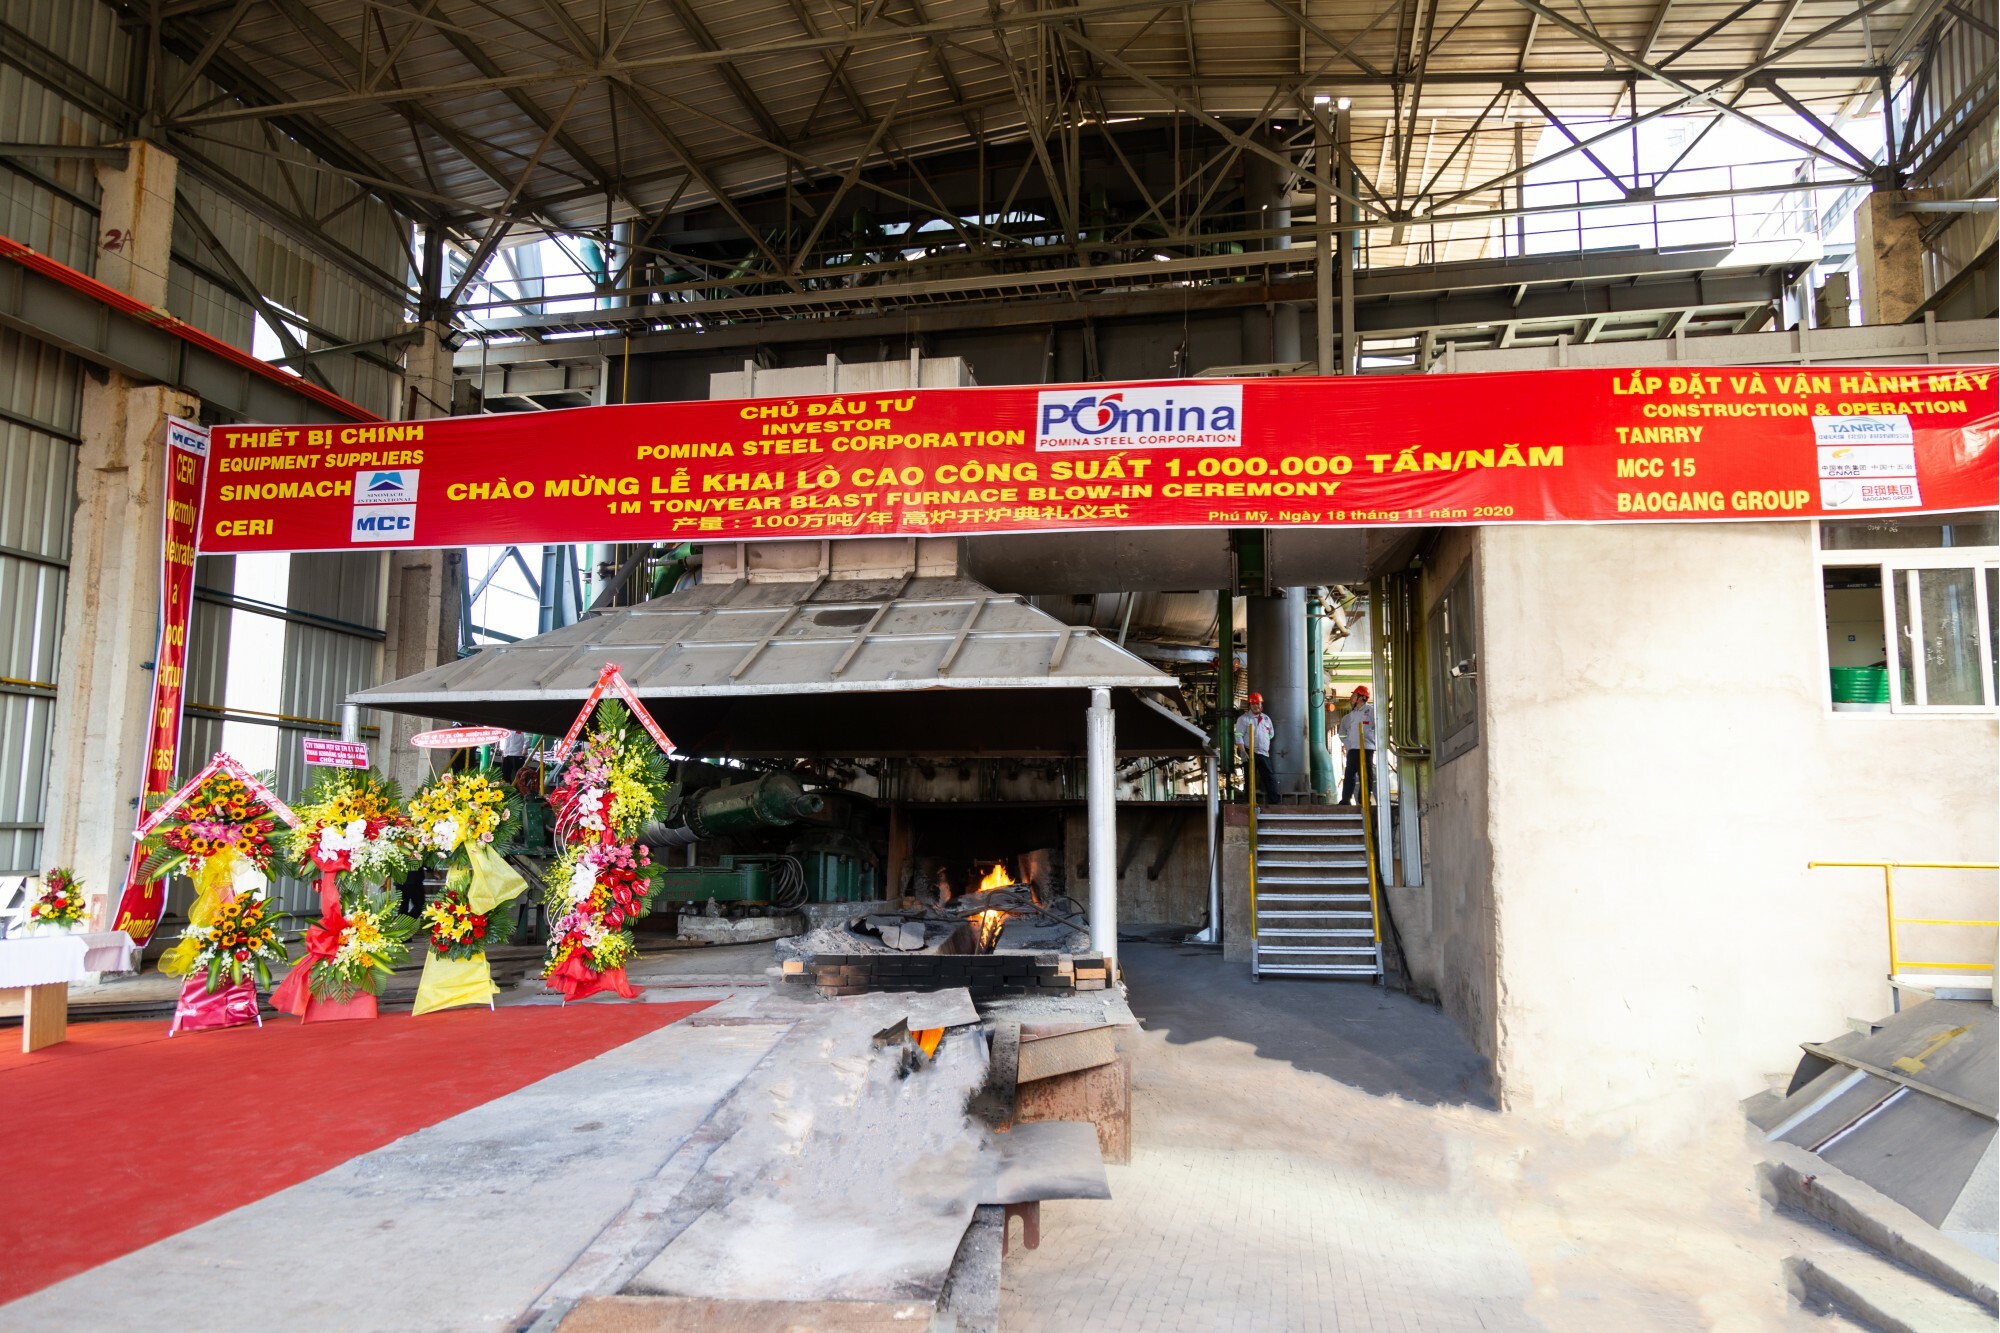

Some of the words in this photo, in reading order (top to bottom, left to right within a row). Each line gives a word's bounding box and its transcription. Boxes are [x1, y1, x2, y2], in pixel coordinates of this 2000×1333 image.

[103, 228, 135, 256] 2A
[1614, 370, 1662, 394] LẮP
[1669, 373, 1721, 399] ĐẶT
[1730, 372, 1767, 394] VÀ
[1774, 373, 1831, 398] VẬN
[1840, 372, 1920, 394] HÀNH
[1927, 370, 1989, 392] MÁY
[741, 401, 798, 419] CHỦ
[808, 398, 866, 416] ĐẦU
[876, 396, 915, 412] TƯ
[1644, 403, 1808, 417] CONSTRUCTION
[1815, 403, 1831, 416] &
[1838, 401, 1967, 416] OPERATION
[309, 430, 332, 448] BỊ
[341, 425, 423, 444] CHÍNH
[763, 419, 890, 435] INVESTOR
[1616, 426, 1703, 443] TANRRY
[1828, 423, 1895, 433] TANRRY
[172, 431, 206, 450] MCC
[638, 443, 733, 459] POMINA
[743, 439, 823, 455] STEEL
[832, 430, 1024, 451] CORPORATION
[1040, 438, 1090, 447] POMINA
[1094, 436, 1134, 446] STEEL
[1138, 434, 1236, 444] CORPORATION
[176, 454, 196, 486] CERI
[220, 455, 320, 472] EQUIPMENT
[325, 450, 423, 467] SUPPLIERS
[1617, 458, 1664, 478] MCC
[1671, 458, 1696, 477] 15
[447, 478, 534, 500] CHÀO
[545, 474, 640, 498] MỪNG
[652, 468, 690, 493] LỄ
[703, 472, 784, 492] KHAI
[797, 465, 840, 489] LÒ
[852, 466, 924, 487] CAO
[935, 460, 1037, 484] CÔNG
[1051, 452, 1151, 480] SUẤT
[1166, 456, 1352, 476] 1.000.000
[1366, 444, 1563, 473] TẤN/NĂM
[220, 481, 351, 501] SINOMACH
[607, 500, 642, 515] 1M
[650, 497, 781, 512] TON/YEAR
[790, 493, 877, 509] BLAST
[886, 488, 1017, 506] FURNACE
[1028, 484, 1153, 501] BLOW-IN
[1162, 482, 1340, 497] CEREMONY
[1617, 491, 1725, 512] BAOGANG
[1731, 490, 1810, 510] GROUP
[1862, 485, 1912, 496] 包钢集团
[167, 499, 196, 533] warmly
[357, 517, 410, 530] MCC
[902, 504, 1128, 525] 高炉开炉典礼仪式
[1209, 512, 1239, 520] Phú
[1280, 511, 1320, 523] Ngày
[1328, 511, 1345, 520] 18
[1351, 510, 1399, 521] tháng
[1406, 509, 1422, 518] 11
[1430, 508, 1467, 518] năm
[1474, 506, 1514, 517] 2020
[216, 519, 273, 536] CERI
[165, 533, 194, 567] lebrate
[172, 584, 178, 604] a
[165, 619, 184, 646] ood
[119, 911, 155, 938] Pomina
